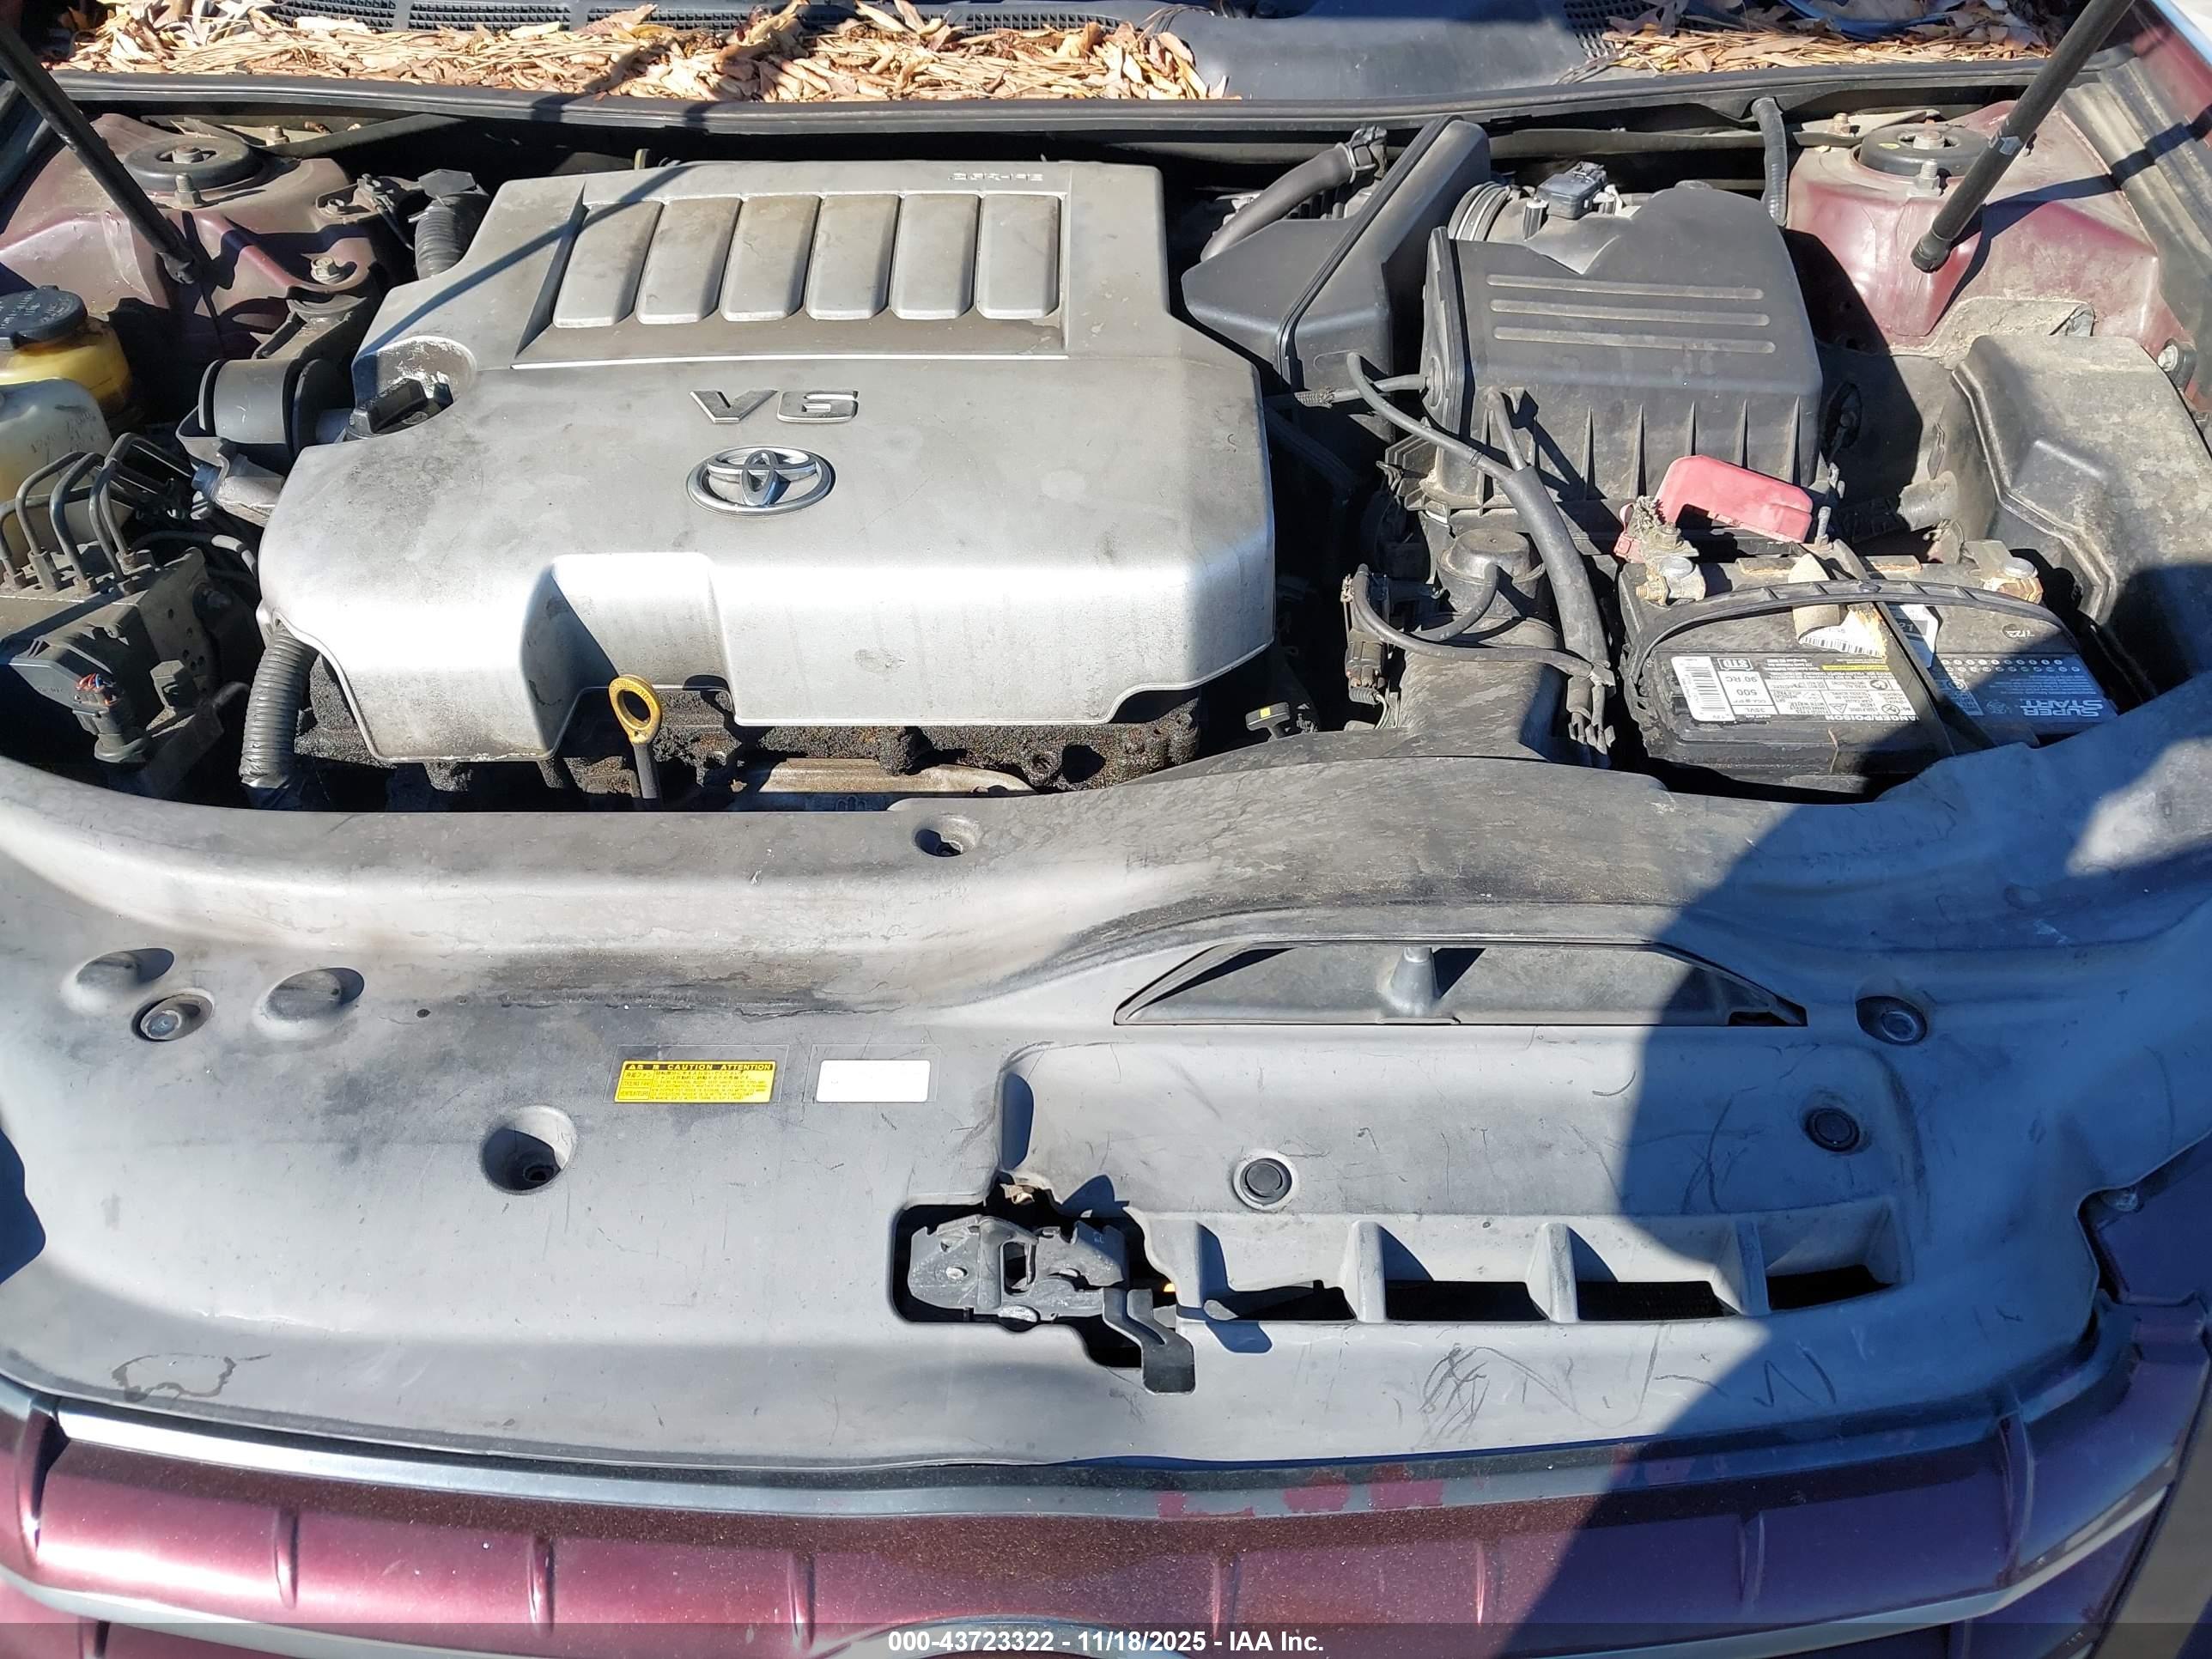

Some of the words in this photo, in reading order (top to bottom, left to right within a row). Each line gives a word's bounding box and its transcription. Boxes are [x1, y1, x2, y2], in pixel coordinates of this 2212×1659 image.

[689, 390, 859, 424] V6
[2020, 699, 2104, 709] START
[2022, 707, 2100, 717] SUPER
